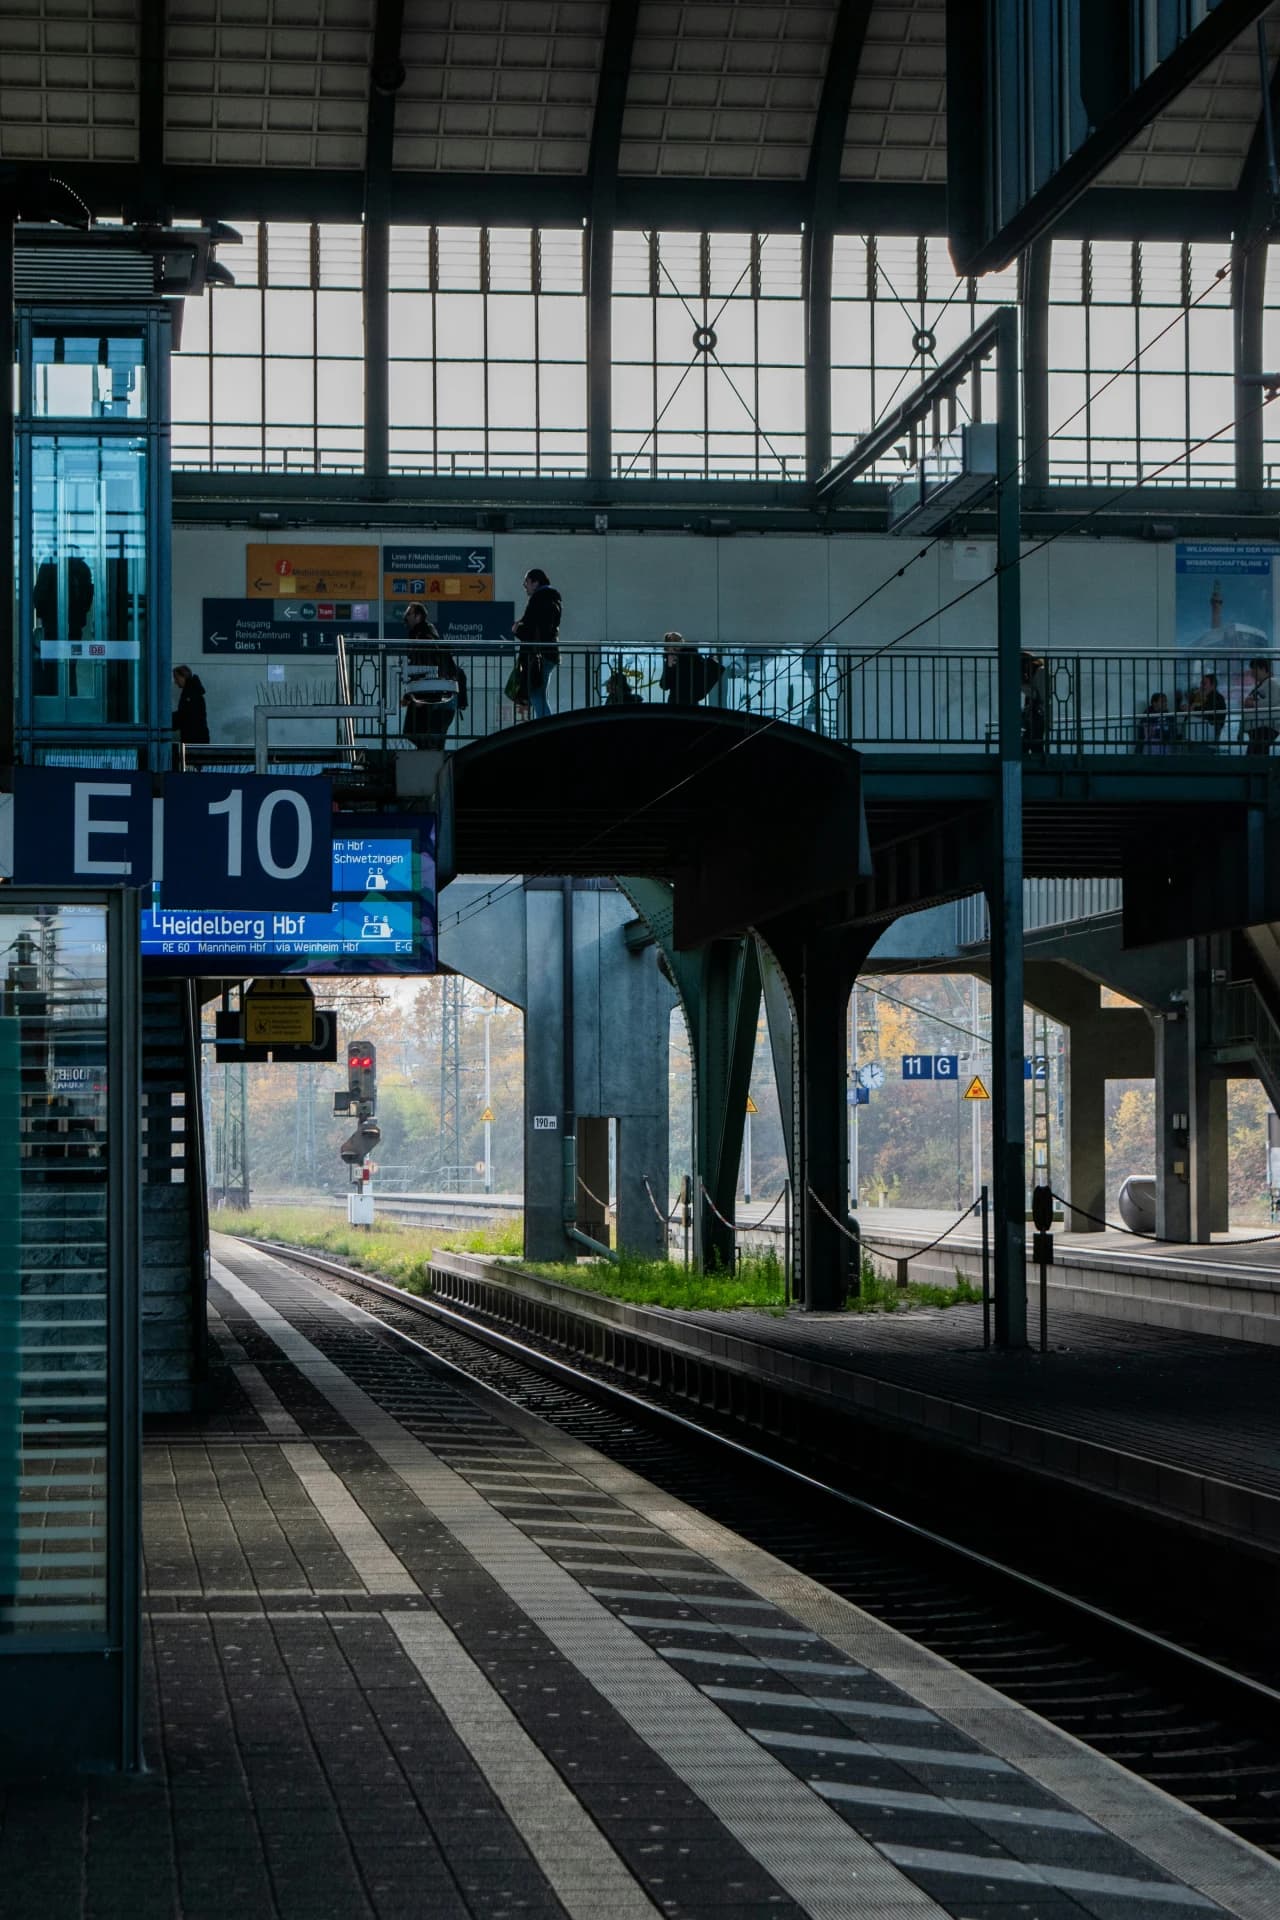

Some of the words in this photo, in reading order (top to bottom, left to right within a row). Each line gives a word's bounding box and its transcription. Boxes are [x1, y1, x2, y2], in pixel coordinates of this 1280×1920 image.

[235, 619, 271, 630] Ausgang
[448, 621, 483, 632] Ausgang
[235, 631, 291, 640] ReiseZentrum
[234, 641, 254, 650] Gleis
[74, 782, 132, 875] E
[208, 788, 313, 880] 10
[347, 841, 364, 851] Hbf
[333, 854, 404, 865] Schwetzingen
[162, 916, 265, 939] Heidelberg
[273, 915, 306, 935] Hbf
[162, 943, 175, 953] RE
[177, 943, 190, 953] 60
[198, 943, 247, 953] Mannheim
[249, 943, 267, 953] Hbf
[276, 943, 291, 953] via
[293, 943, 339, 953] Weinheim
[342, 942, 360, 953] Hbf
[395, 942, 412, 952] E-G
[905, 1057, 921, 1075] 11
[936, 1057, 951, 1075] G
[535, 1118, 548, 1128] 190
